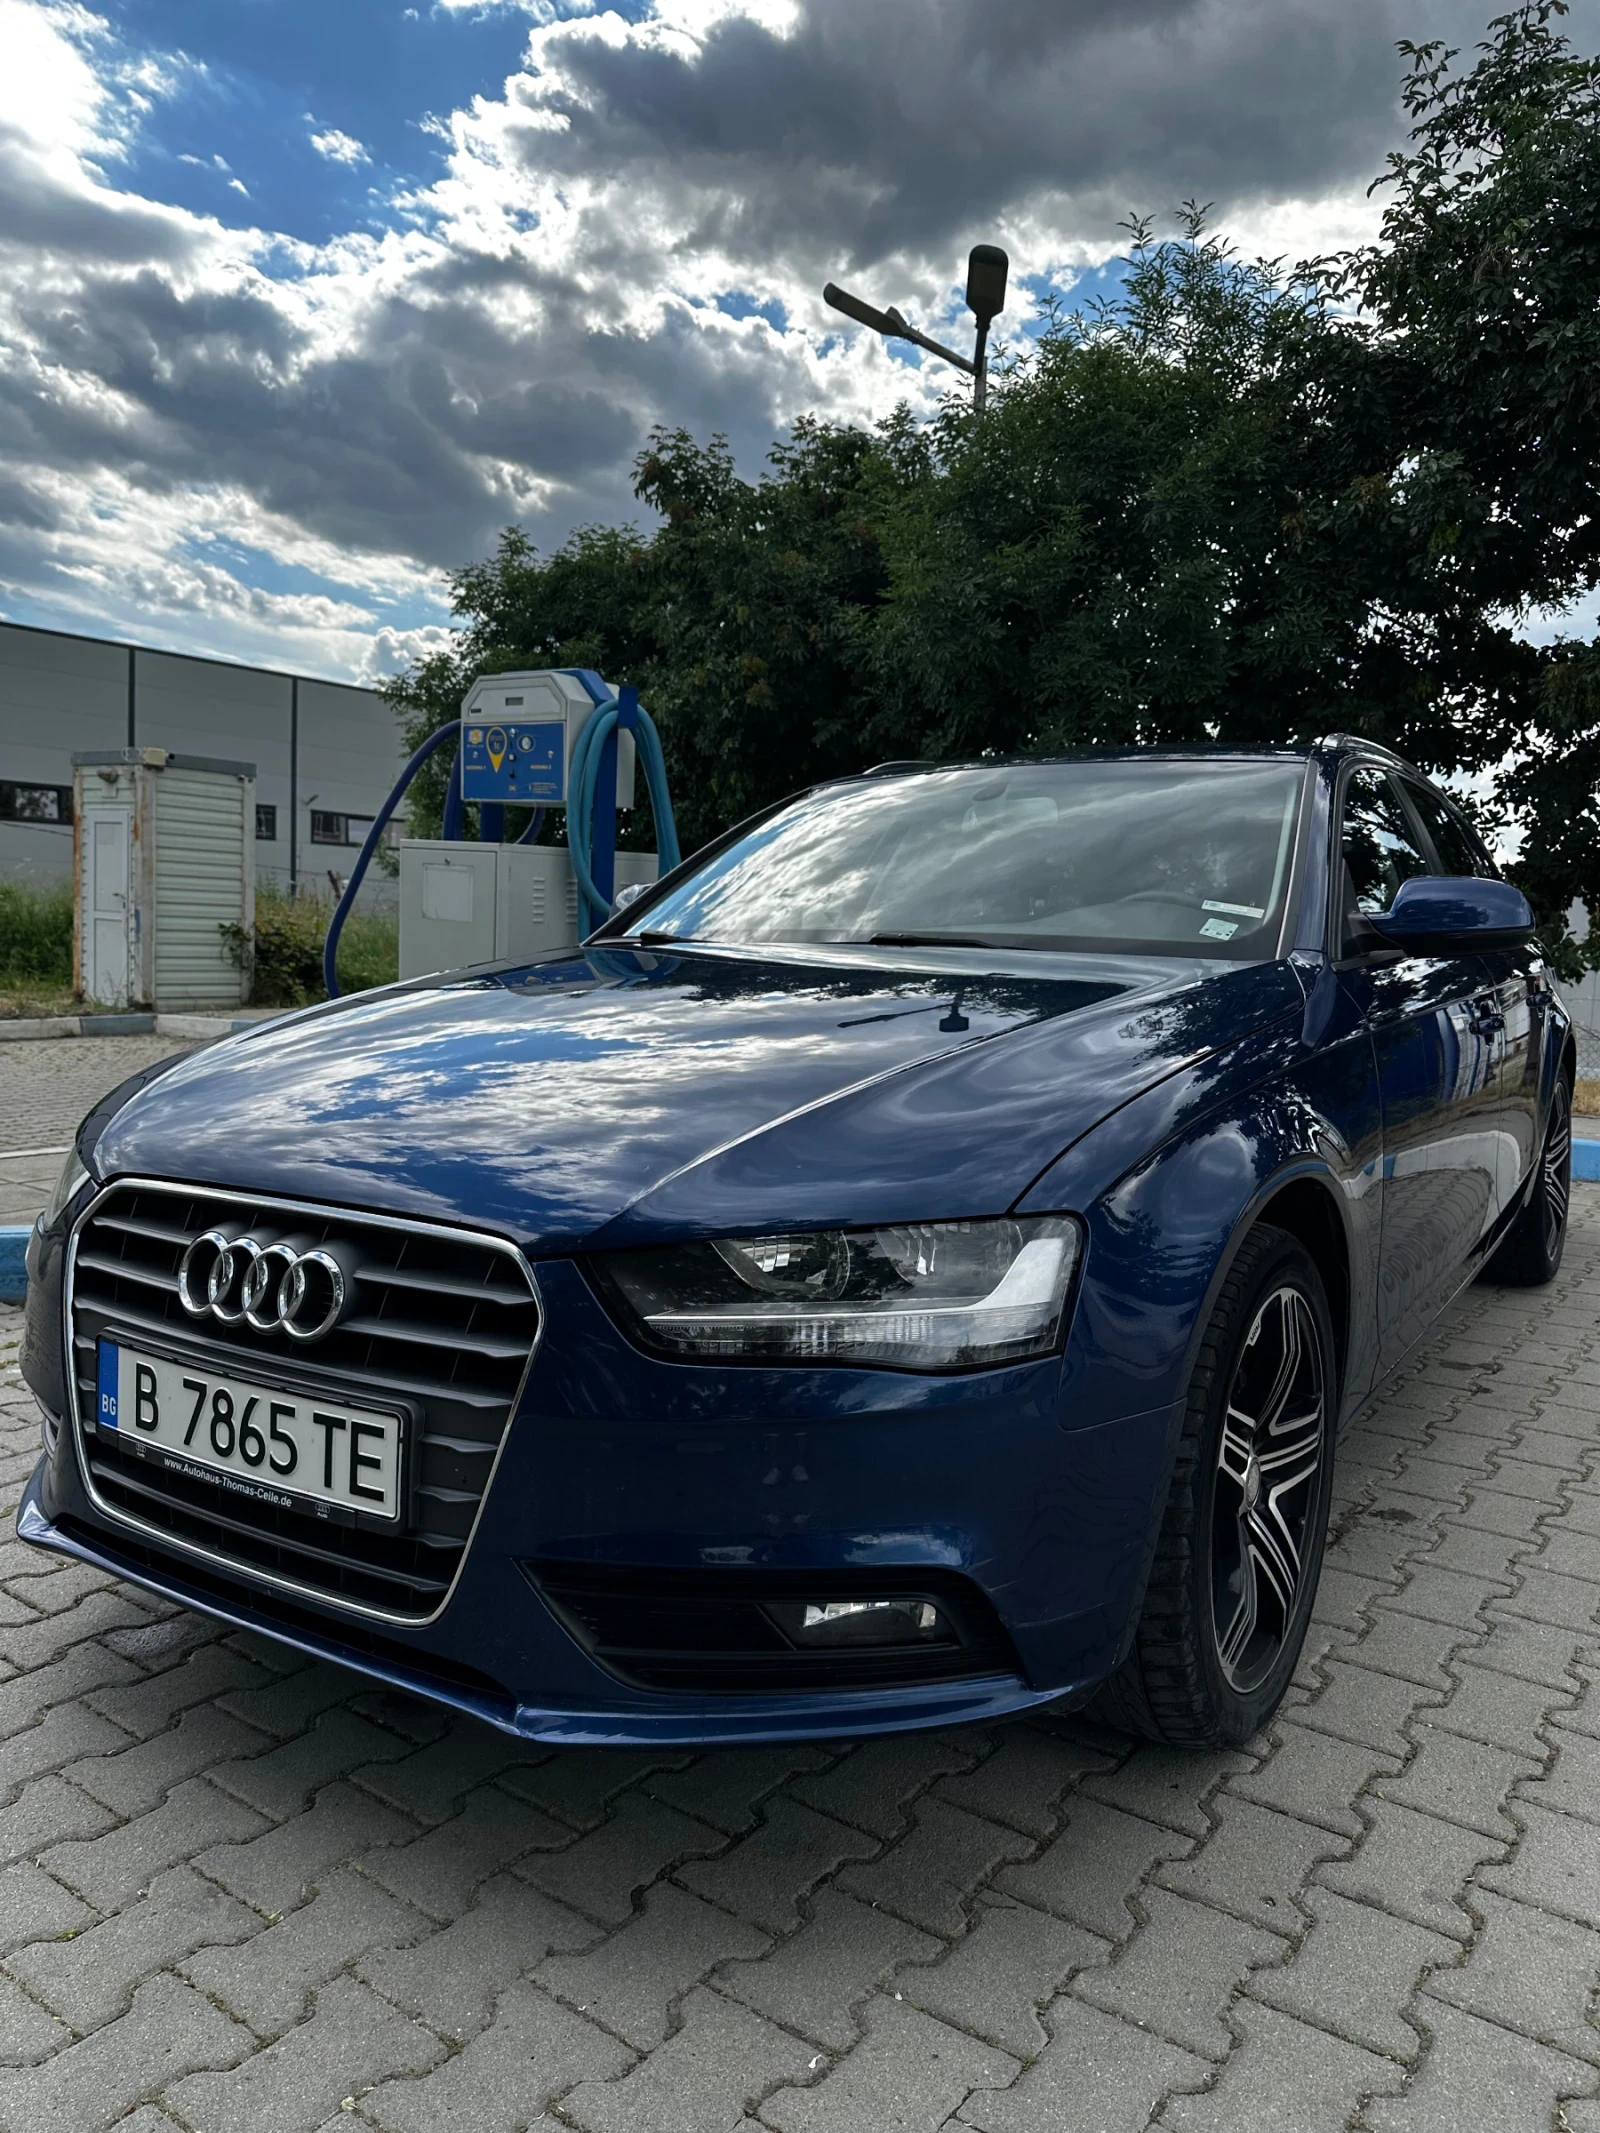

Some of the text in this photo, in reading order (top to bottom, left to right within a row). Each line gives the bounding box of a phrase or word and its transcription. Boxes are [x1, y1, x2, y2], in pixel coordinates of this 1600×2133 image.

[101, 1393, 117, 1417] BG
[135, 1361, 386, 1502] B 7865 TE
[164, 1456, 293, 1508] www.Autohaus-Thomas-Celle.de
